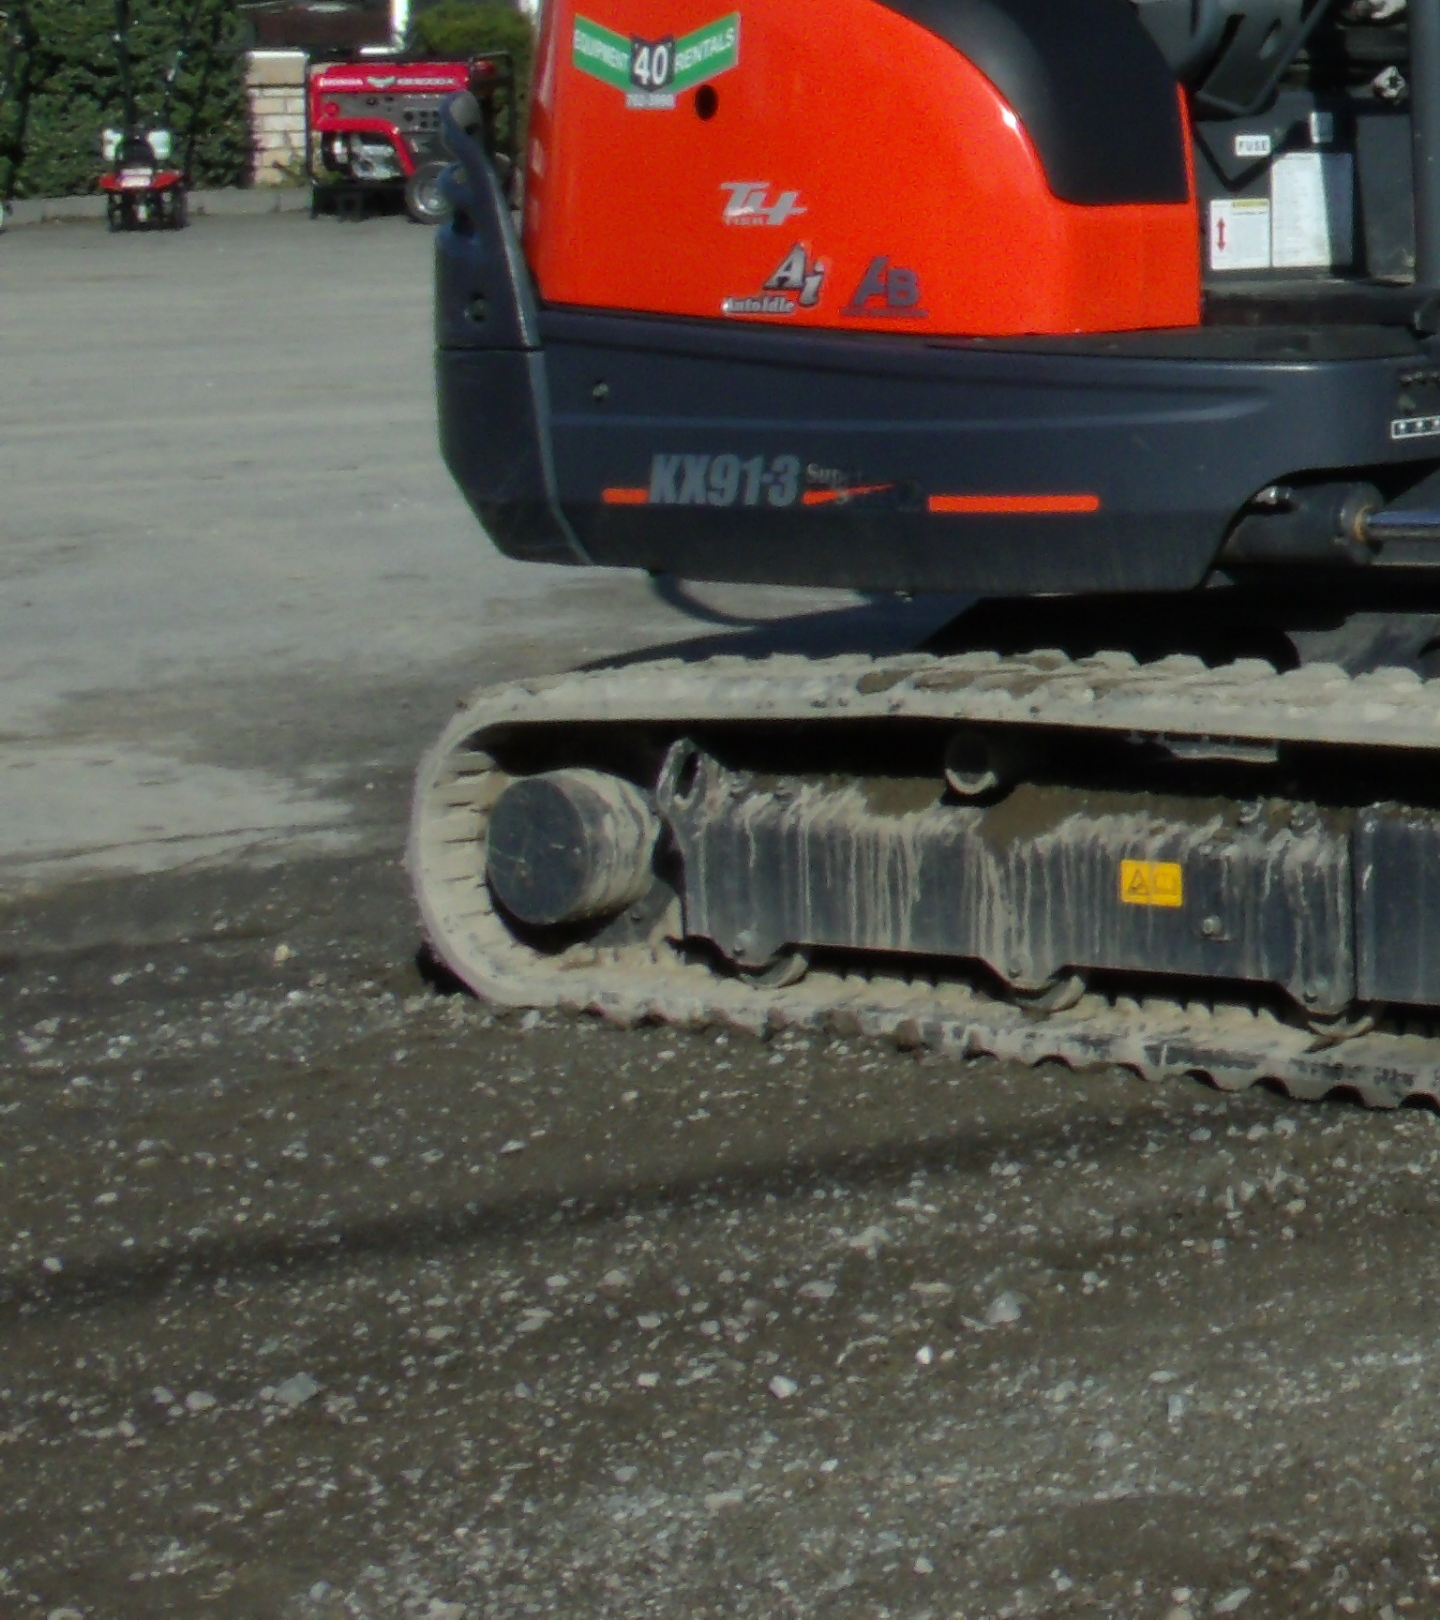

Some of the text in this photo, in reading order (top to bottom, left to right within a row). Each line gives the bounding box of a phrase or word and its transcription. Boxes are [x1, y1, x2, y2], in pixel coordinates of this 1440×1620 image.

[675, 27, 735, 74] RENTALS
[1238, 140, 1268, 152] FUSE
[649, 453, 800, 508] KX91-3
